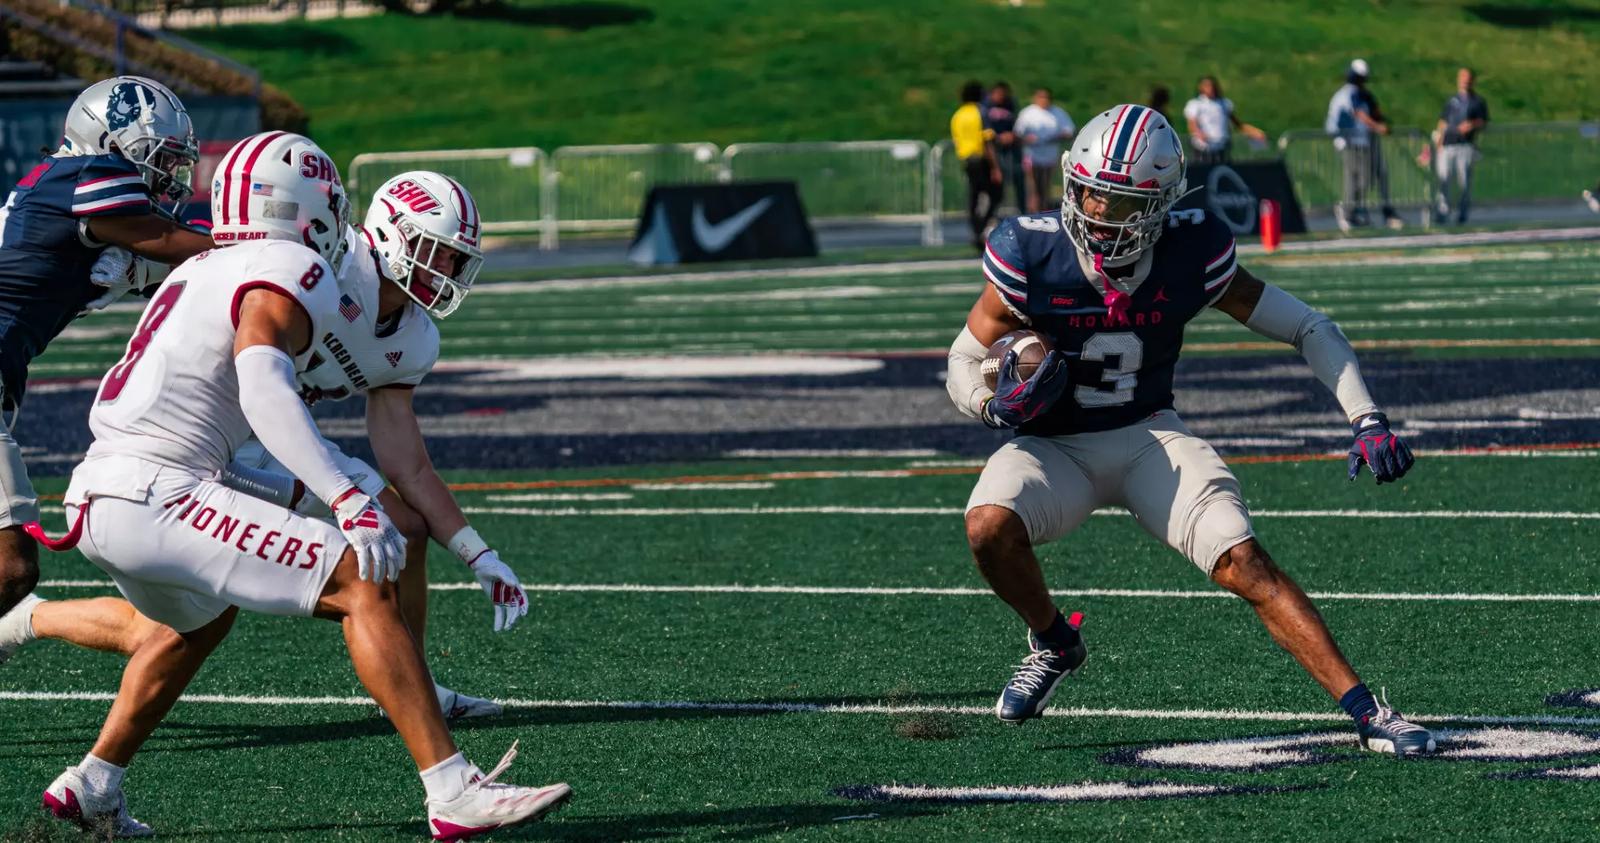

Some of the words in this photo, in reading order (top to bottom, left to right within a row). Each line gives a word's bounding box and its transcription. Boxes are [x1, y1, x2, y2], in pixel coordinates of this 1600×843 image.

[388, 180, 440, 213] SHU
[237, 231, 268, 241] HEART
[299, 262, 325, 291] 8
[1069, 311, 1162, 328] HOWARD
[98, 281, 187, 405] 8
[321, 331, 353, 366] ACRED
[343, 361, 370, 391] HEAR
[1073, 331, 1143, 408] 3
